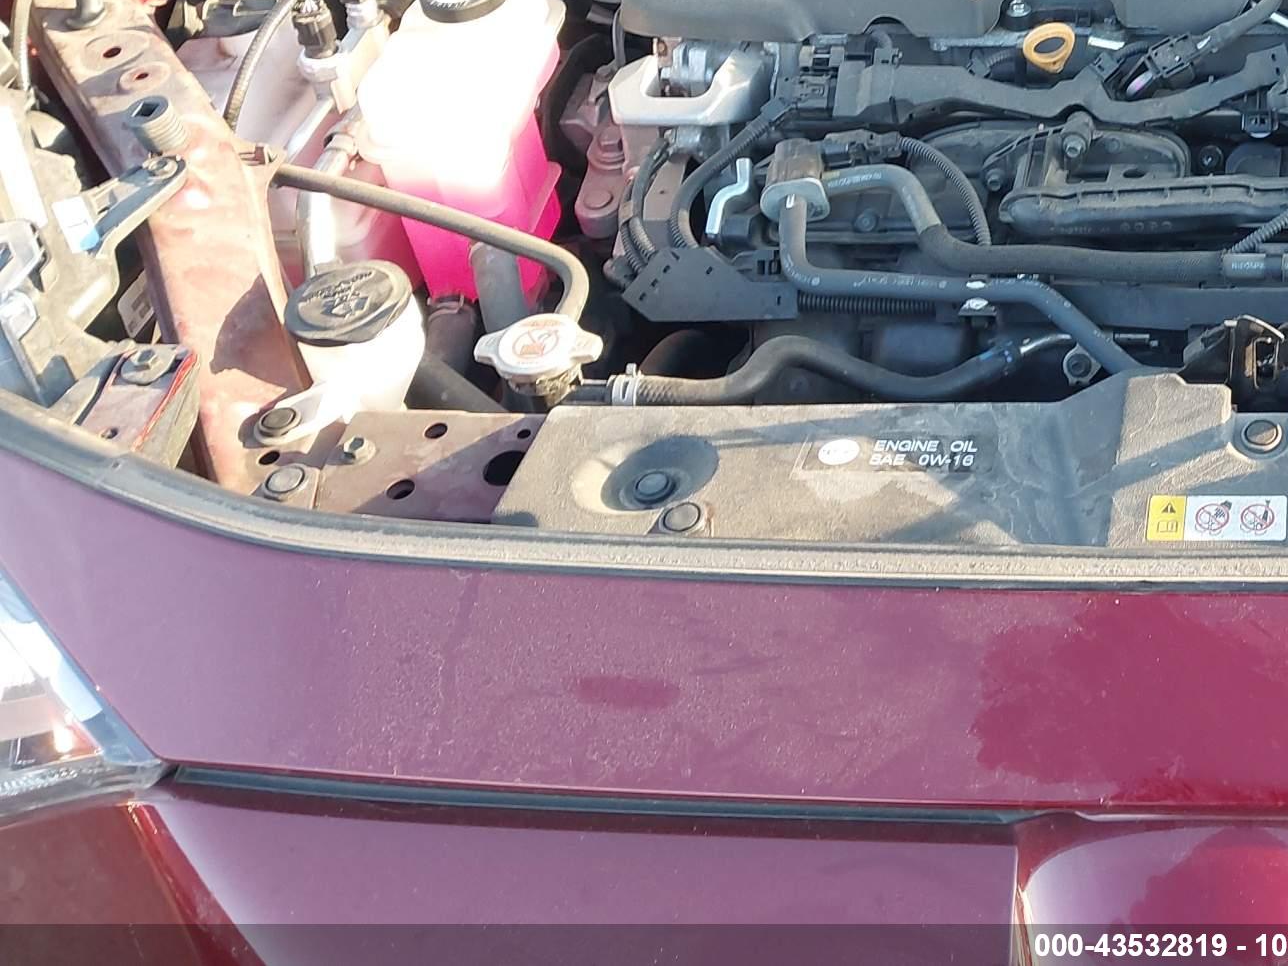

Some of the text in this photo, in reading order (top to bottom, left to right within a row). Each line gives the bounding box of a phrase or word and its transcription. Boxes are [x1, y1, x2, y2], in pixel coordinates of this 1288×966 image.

[873, 440, 978, 452] ENGINE OIL
[869, 454, 974, 466] SAE 0W-16
